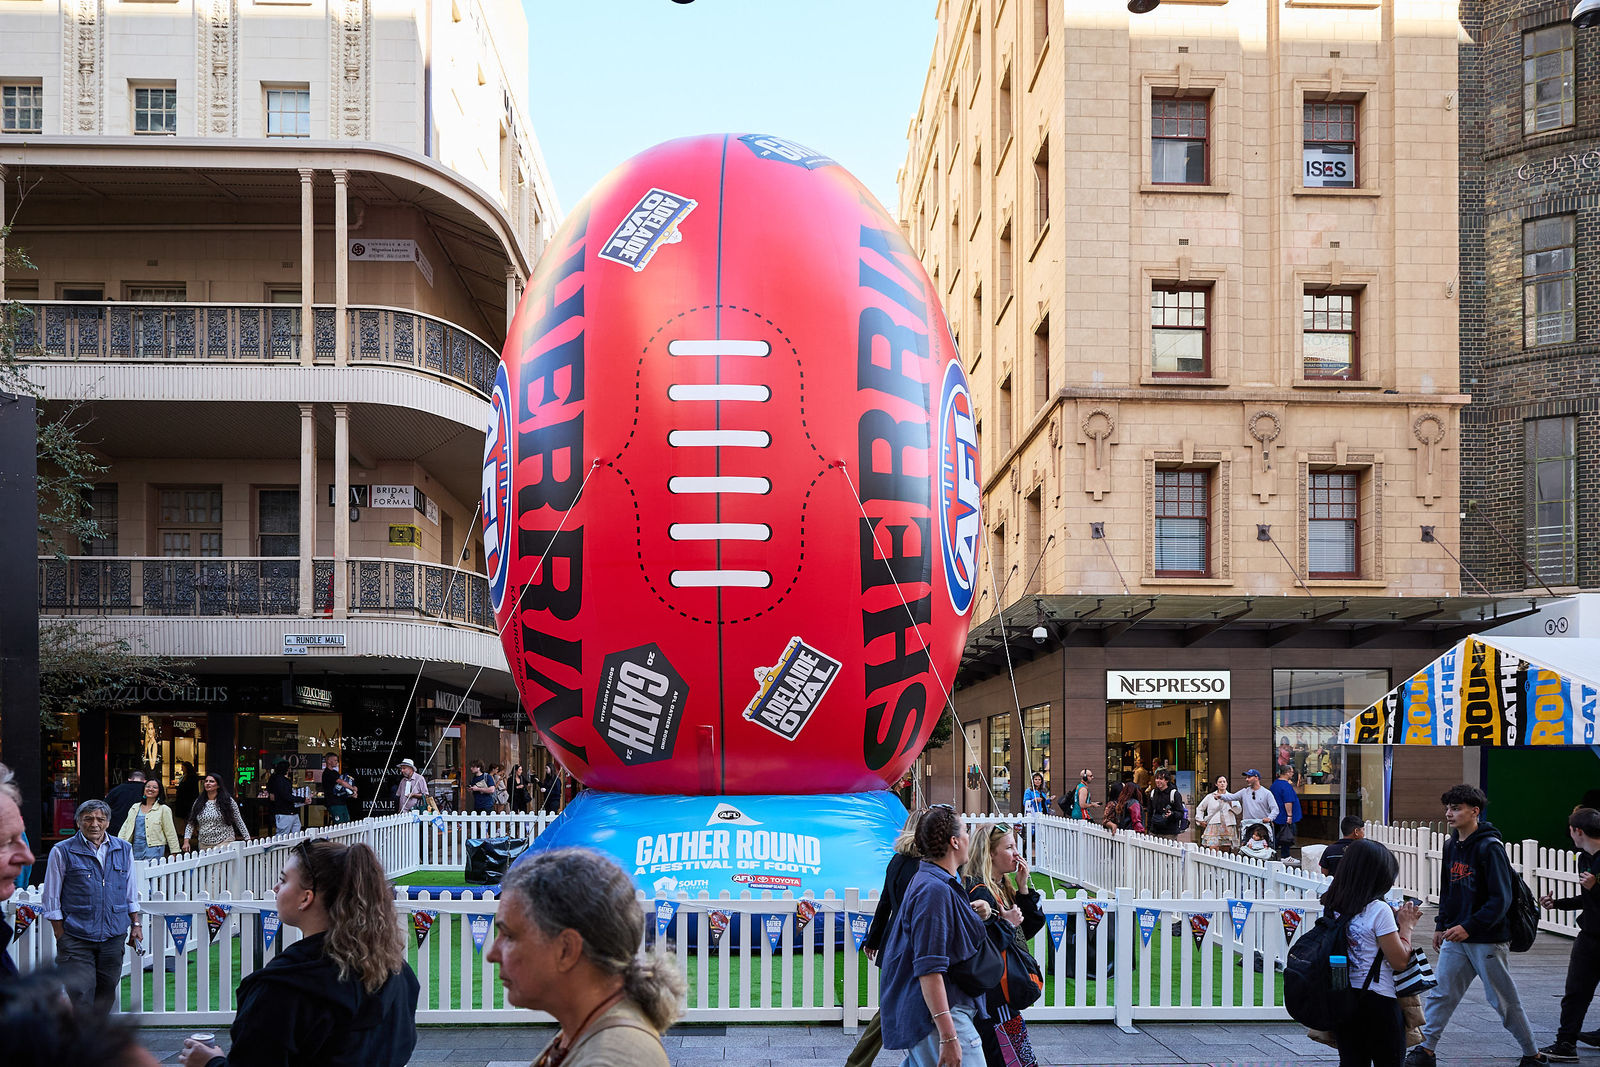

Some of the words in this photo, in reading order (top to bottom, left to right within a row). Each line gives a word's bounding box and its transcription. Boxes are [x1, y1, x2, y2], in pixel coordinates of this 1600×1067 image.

[1306, 160, 1346, 178] ISES
[605, 193, 664, 254] OVAL
[618, 197, 680, 262] ADELAIDE
[376, 486, 409, 494] BRIDAL
[518, 202, 590, 766] HERRIN
[954, 388, 980, 595] AFL
[325, 636, 343, 644] MALL
[646, 651, 656, 666] 20
[760, 650, 820, 727] ADELAIDE
[1117, 675, 1225, 695] NESPRESSO
[92, 686, 228, 701] AZZUCCHELLI'S
[671, 690, 679, 703] AFL
[779, 665, 835, 733] OVAL
[1441, 648, 1456, 745] GATHE
[600, 689, 610, 723] AUSTRALIA
[607, 661, 669, 754] GATH
[173, 721, 197, 729] LONGINES
[625, 748, 633, 760] 24
[719, 811, 740, 819] AFL
[635, 829, 730, 866] GATHER
[735, 830, 821, 866] ROUND
[633, 866, 646, 876] A
[650, 860, 733, 873] FESTIVAL
[737, 860, 761, 870] OF
[763, 860, 821, 876] FOOTY
[678, 879, 709, 888] SOUTH
[733, 875, 754, 883] AFL
[770, 877, 800, 885] TOYOTA
[171, 921, 188, 929] GATHER
[264, 916, 280, 925] GATHER
